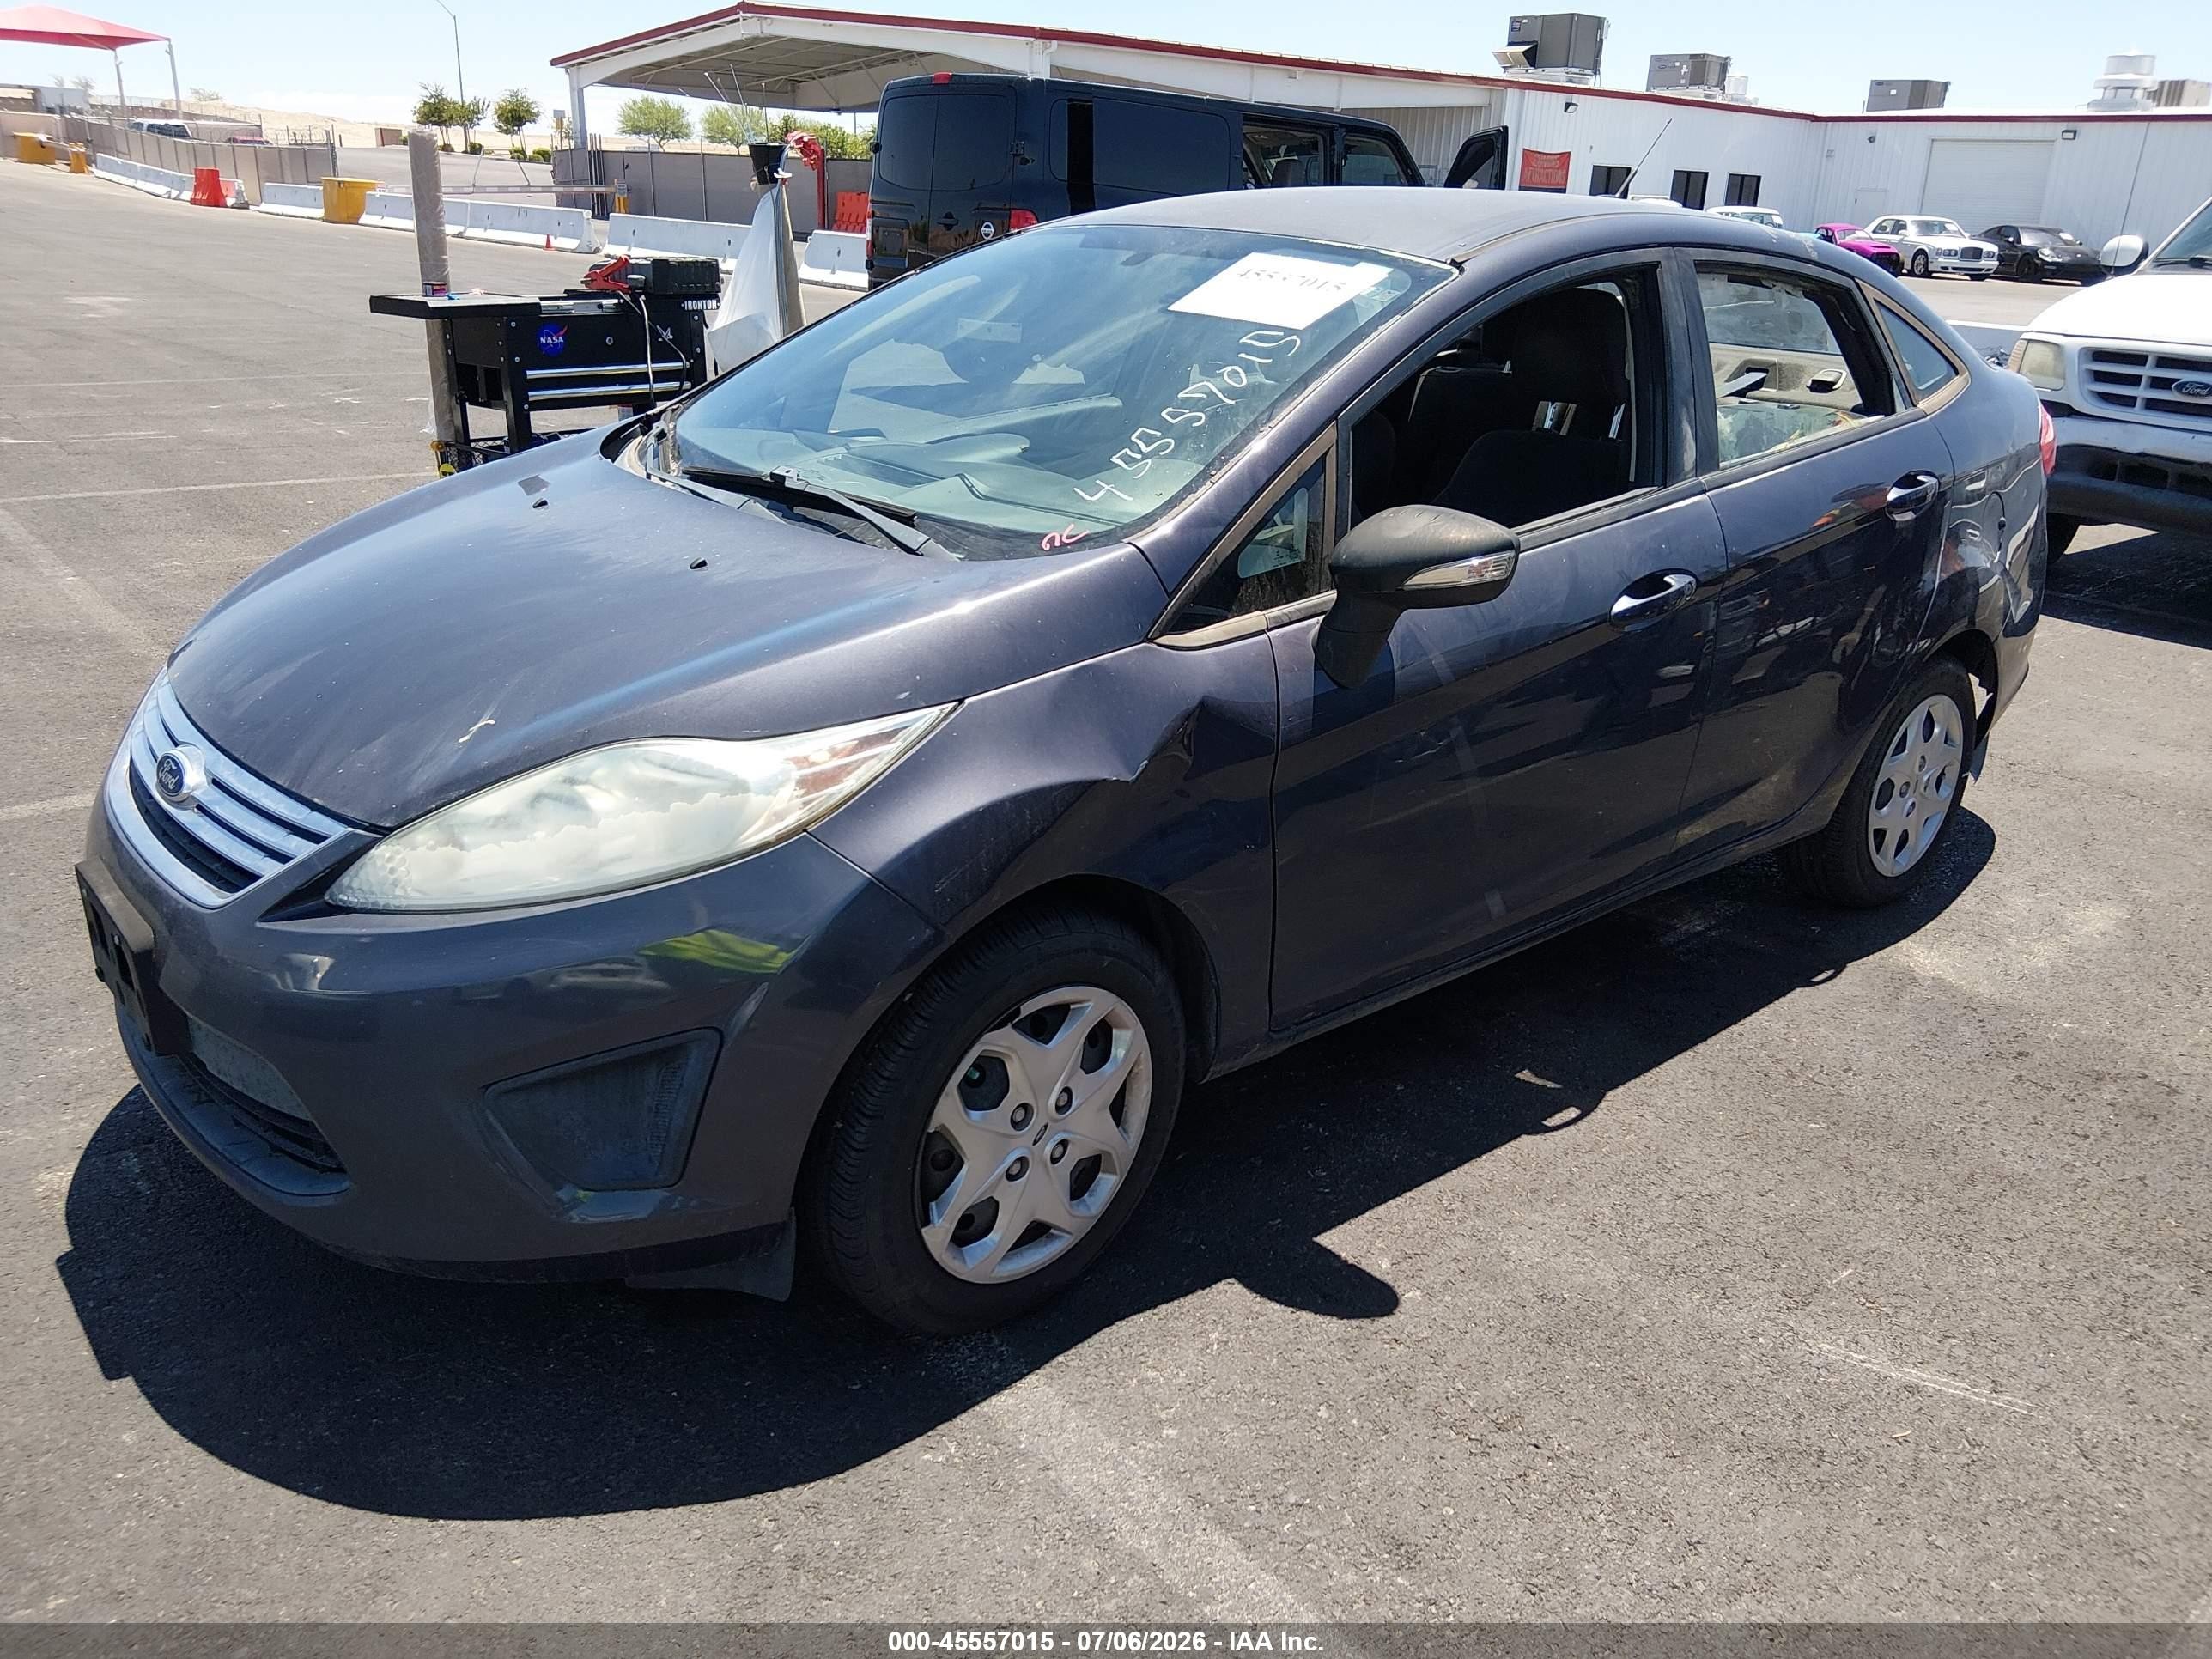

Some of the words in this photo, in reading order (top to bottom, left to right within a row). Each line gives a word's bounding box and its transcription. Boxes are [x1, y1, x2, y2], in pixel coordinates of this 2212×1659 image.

[684, 299, 717, 310] IRONTON
[540, 336, 564, 344] NASA
[2182, 382, 2212, 395] Ford
[1073, 329, 1301, 502] 45557015
[159, 759, 179, 790] Ford
